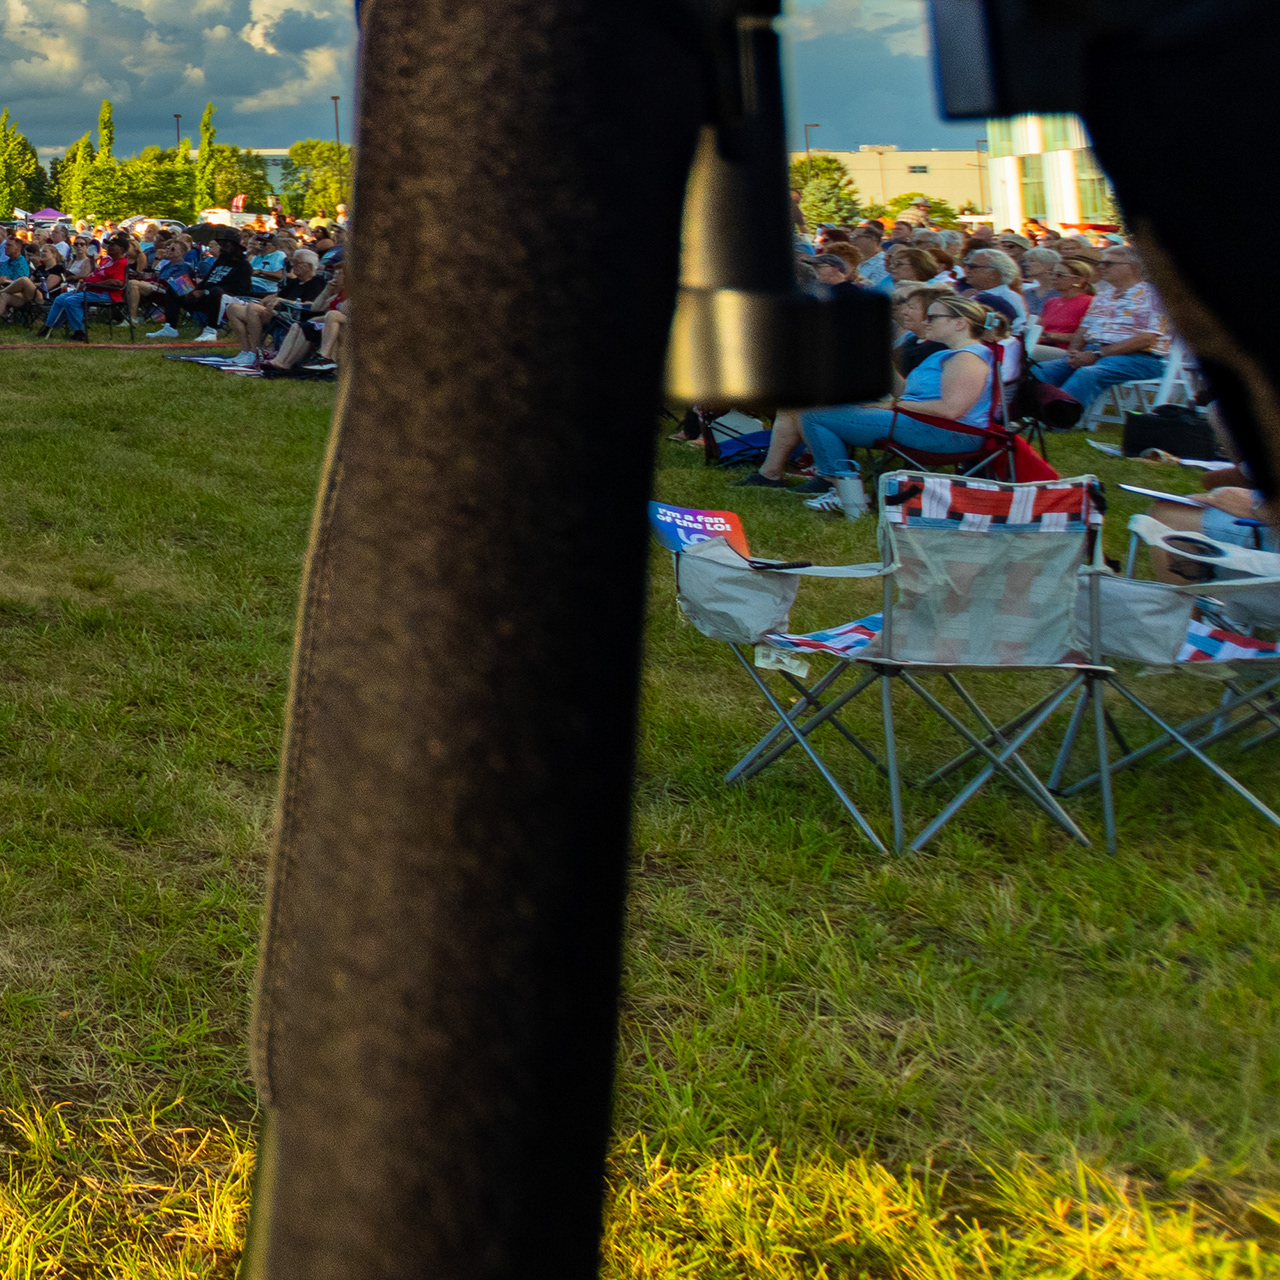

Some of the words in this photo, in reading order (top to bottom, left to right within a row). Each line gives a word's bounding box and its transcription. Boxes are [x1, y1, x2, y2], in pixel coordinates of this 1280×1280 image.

[656, 514, 673, 523] of
[674, 518, 703, 530] the
[705, 523, 732, 532] LO!
[657, 507, 681, 519] I'm
[696, 515, 725, 524] fan
